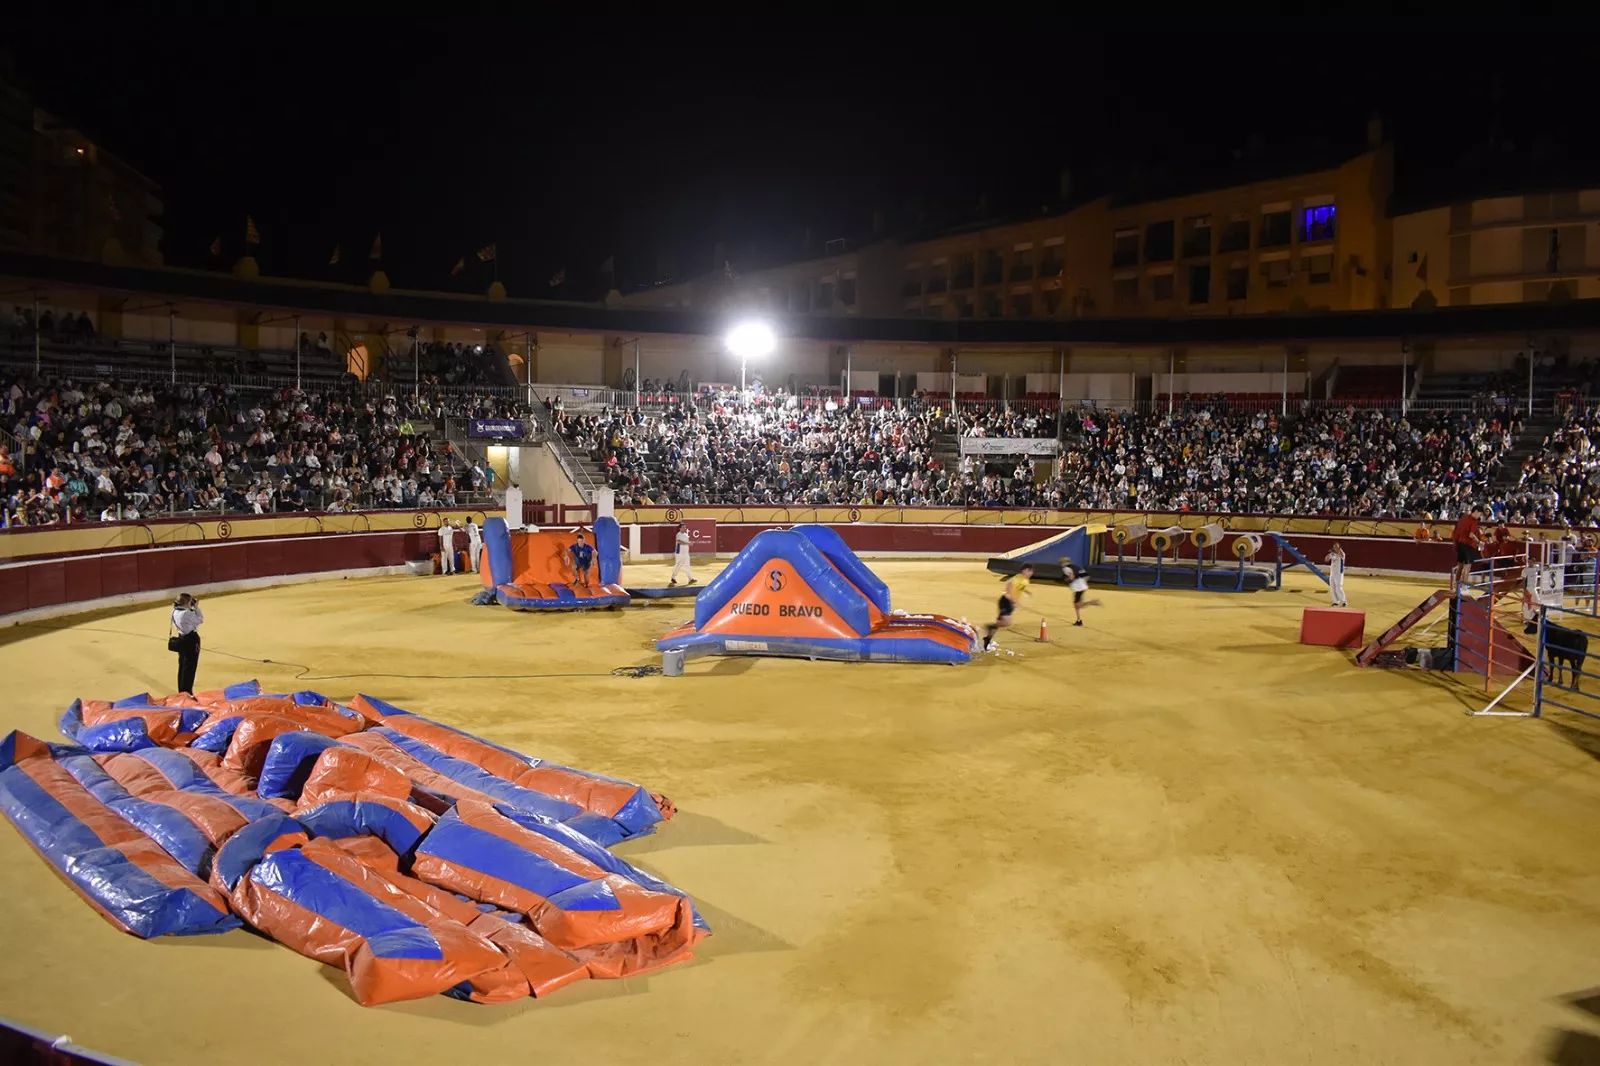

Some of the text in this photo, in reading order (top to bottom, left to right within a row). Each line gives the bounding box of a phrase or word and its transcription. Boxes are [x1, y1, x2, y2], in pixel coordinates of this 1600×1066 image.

[416, 516, 422, 526] 5
[220, 524, 228, 536] 5
[730, 603, 823, 618] RUEDO BRAVO
